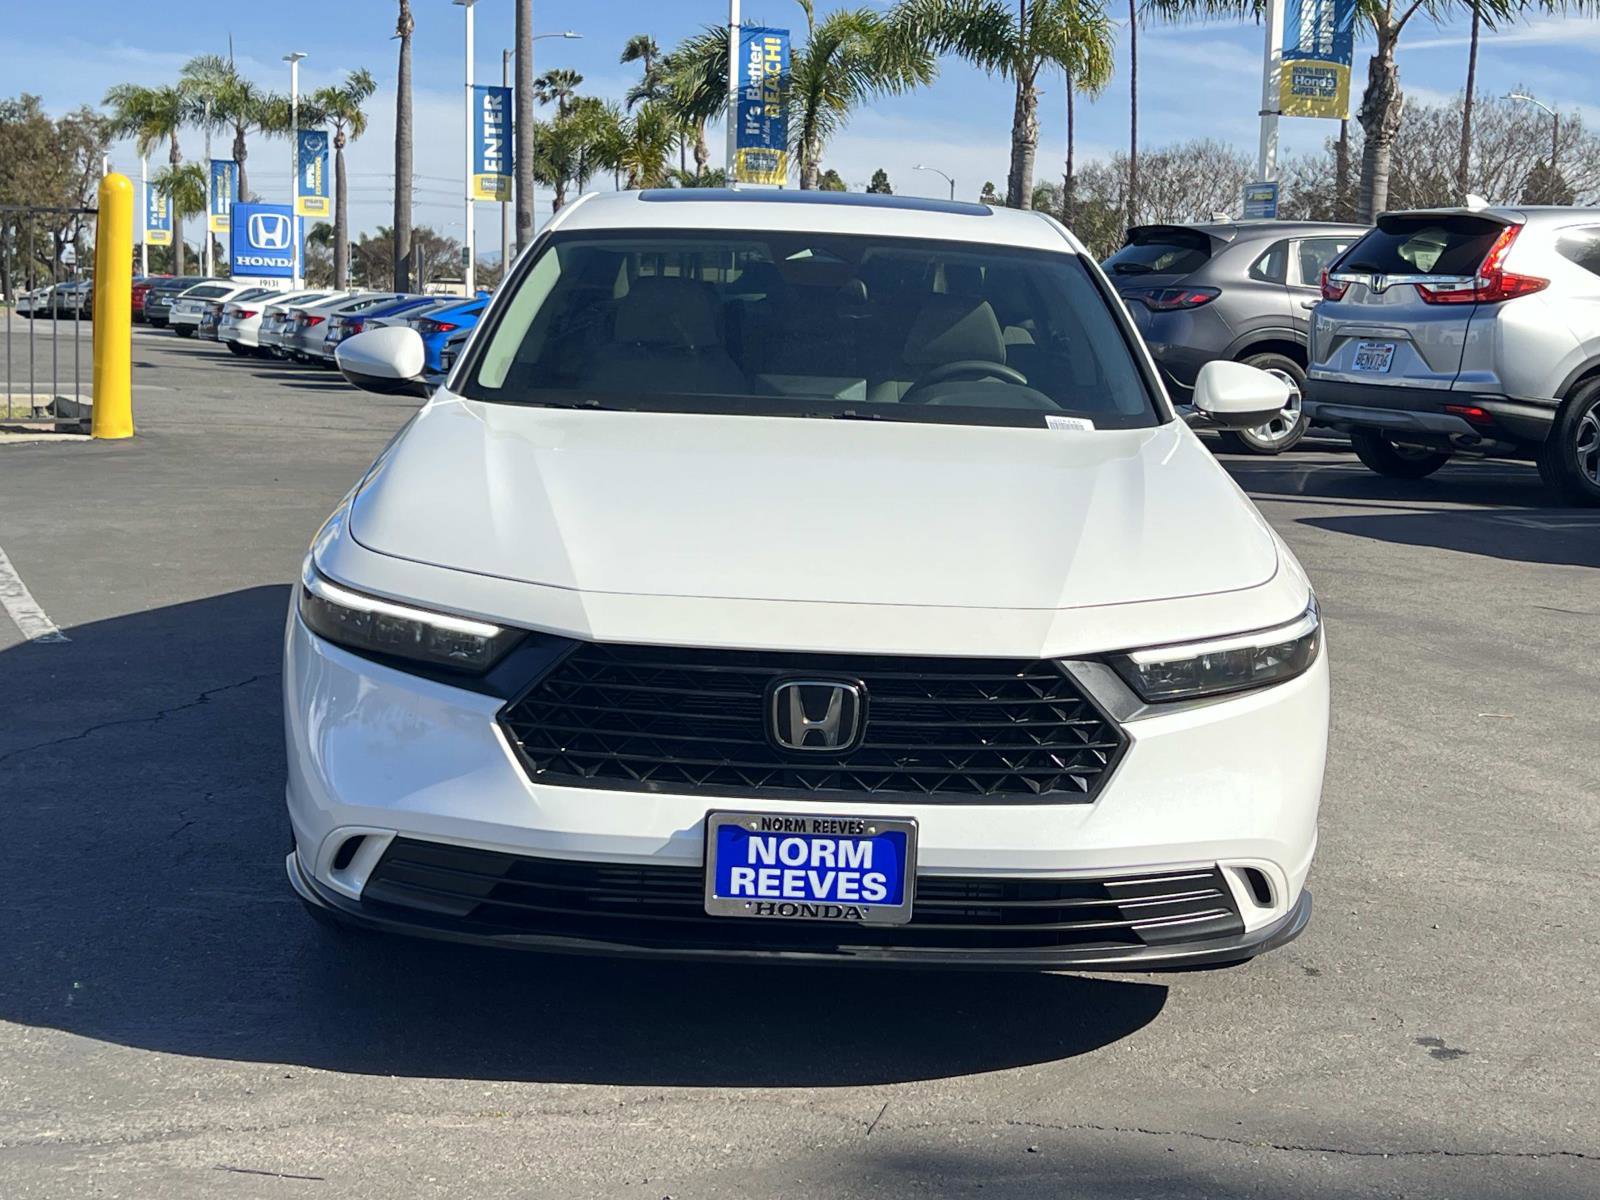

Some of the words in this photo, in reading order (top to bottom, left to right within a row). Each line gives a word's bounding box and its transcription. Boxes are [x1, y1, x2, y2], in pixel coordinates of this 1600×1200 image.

[746, 42, 762, 100] Better
[1295, 76, 1335, 87] Honda
[745, 105, 761, 135] It's
[483, 95, 503, 171] ENTER
[236, 256, 293, 268] HOND
[259, 279, 279, 287] 19131
[761, 817, 807, 833] NORM
[812, 818, 864, 835] REEVES
[748, 836, 873, 869] NORM
[730, 867, 887, 901] REEVES
[754, 902, 866, 920] HONDA
